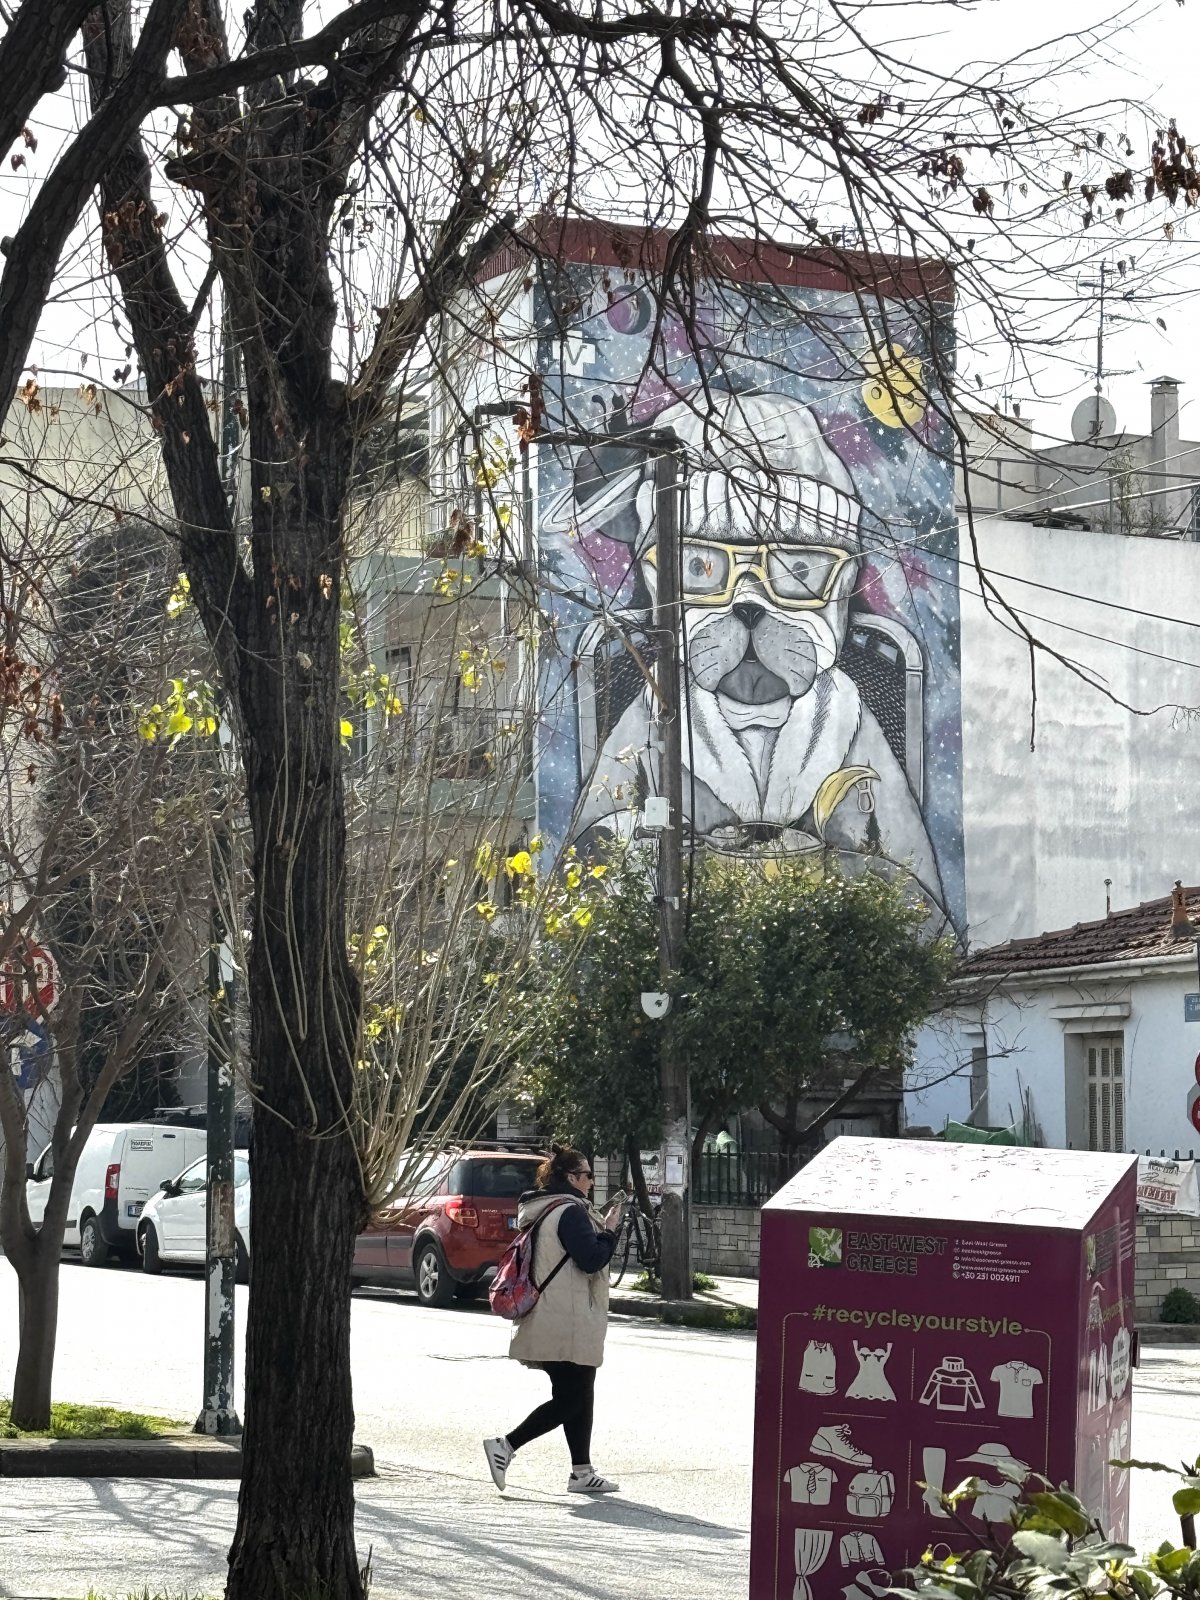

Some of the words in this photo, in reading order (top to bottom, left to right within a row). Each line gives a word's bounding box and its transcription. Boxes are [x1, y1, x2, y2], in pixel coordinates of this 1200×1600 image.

[846, 1231, 949, 1255] EAST-WEST
[845, 1252, 918, 1276] GREECE
[961, 1271, 975, 1280] +30
[976, 1272, 989, 1281] 231
[812, 1303, 1023, 1338] #recycleyourstyle
